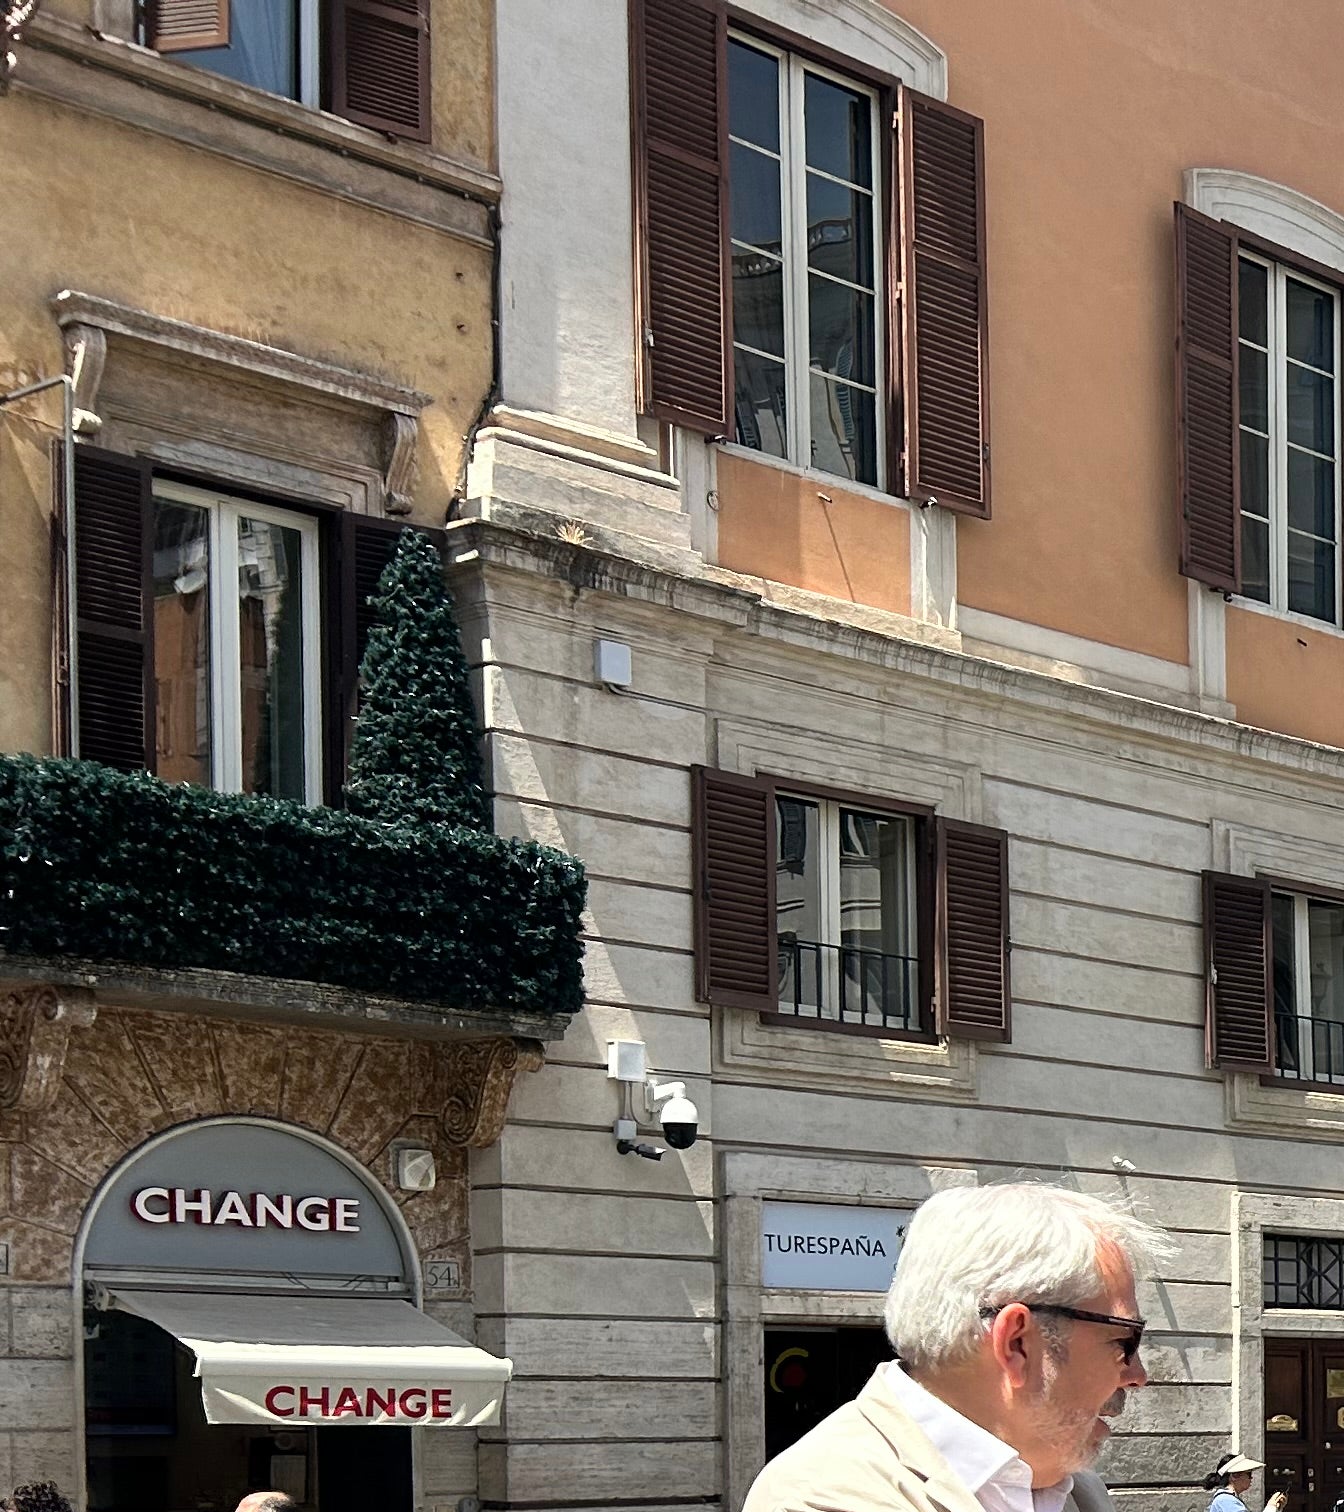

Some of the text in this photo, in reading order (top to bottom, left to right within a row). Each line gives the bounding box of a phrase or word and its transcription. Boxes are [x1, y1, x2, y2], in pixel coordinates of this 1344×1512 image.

[132, 1186, 360, 1233] CHANGE
[764, 1233, 887, 1257] TURESPAÑA
[265, 1385, 453, 1418] CHANGE
